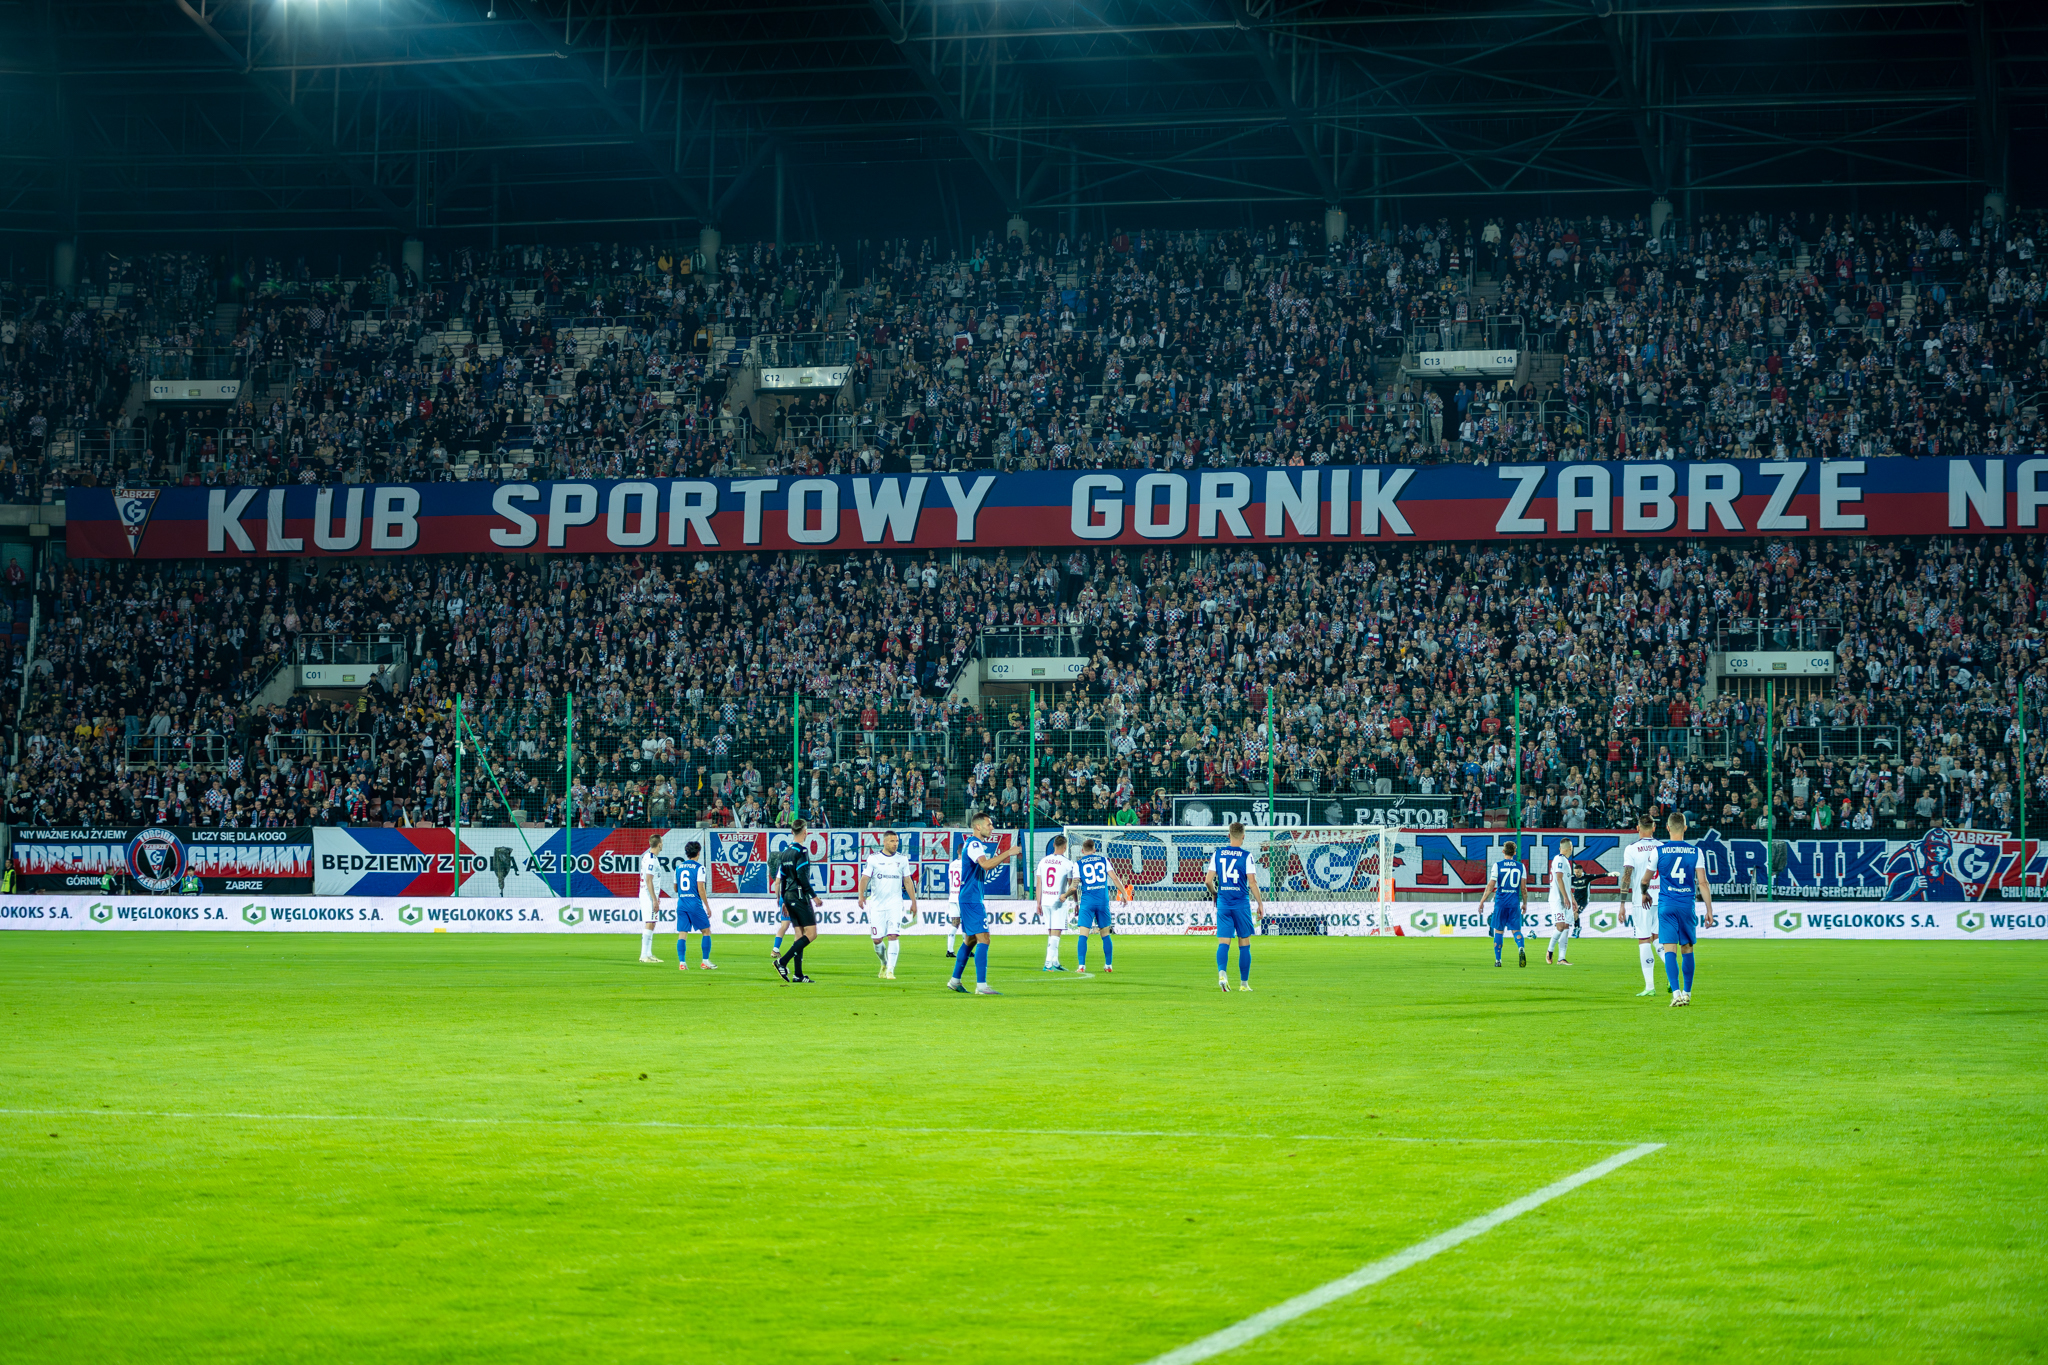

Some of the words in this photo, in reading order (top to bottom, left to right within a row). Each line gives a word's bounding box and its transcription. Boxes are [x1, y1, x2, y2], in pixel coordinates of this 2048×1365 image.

[1423, 357, 1441, 366] C13
[1496, 356, 1514, 364] C14
[764, 374, 780, 382] C12
[153, 386, 169, 394] C11
[220, 385, 237, 393] C12
[119, 490, 156, 499] ABRZE
[207, 486, 421, 553] KLUB
[489, 475, 997, 549] SPORTOWY
[1070, 468, 1417, 539] GORNIK
[1495, 460, 1867, 533] ZABRZE
[991, 664, 1009, 673] C02
[1729, 658, 1749, 668] C03
[1811, 658, 1830, 667] C04
[305, 671, 321, 680] C01
[1221, 811, 1302, 826] DAWID
[1354, 808, 1449, 825] PASTOR
[20, 830, 35, 839] NIY
[36, 828, 68, 840] WAŻNE
[70, 830, 89, 839] KAJ
[90, 828, 128, 839] ŻYJEMY
[137, 829, 176, 844] TORCIDA
[192, 831, 219, 841] LICZY
[220, 831, 236, 843] SIĘ
[237, 831, 257, 841] DLA
[258, 832, 287, 841] KOGO
[721, 833, 755, 842] ZABRZE
[1949, 831, 2003, 845] ZABRZE
[14, 844, 129, 873] TORCIDA
[188, 845, 312, 875] GERMANY
[322, 854, 434, 875] BĘDZIEMY
[438, 854, 454, 873] Z
[460, 855, 520, 877] TOĄ
[525, 851, 556, 873] AŻ
[561, 854, 594, 873] DO
[1694, 828, 1889, 889] ÓRNIK
[1046, 866, 1056, 888] 6
[1082, 861, 1107, 885] 93
[1219, 857, 1240, 884] 14
[1500, 867, 1521, 888] 70
[1670, 856, 1687, 885] 4
[225, 880, 263, 890] ZABRZE
[680, 869, 691, 891] 6
[949, 870, 961, 888] 13
[1821, 886, 1855, 898] SERCA
[1855, 886, 1888, 898] ZNANY
[0, 906, 45, 919] OKOKS
[49, 906, 73, 919] S.A.
[117, 906, 199, 922] WĘGLOKOKS
[203, 907, 228, 920] S.A.
[270, 907, 354, 923] WĘGLOKOKS
[358, 908, 384, 921] S.A.
[428, 908, 514, 924] WĘGLOKOKS
[518, 909, 544, 921] S.A.
[588, 909, 676, 924] WĘGLOKS
[1018, 912, 1046, 925] S.A.
[1725, 914, 1753, 928] S.A.
[1807, 914, 1905, 930] WĘGLOKOKS
[1910, 914, 1940, 928] S.A.
[1990, 914, 2048, 930] WĘGLO
